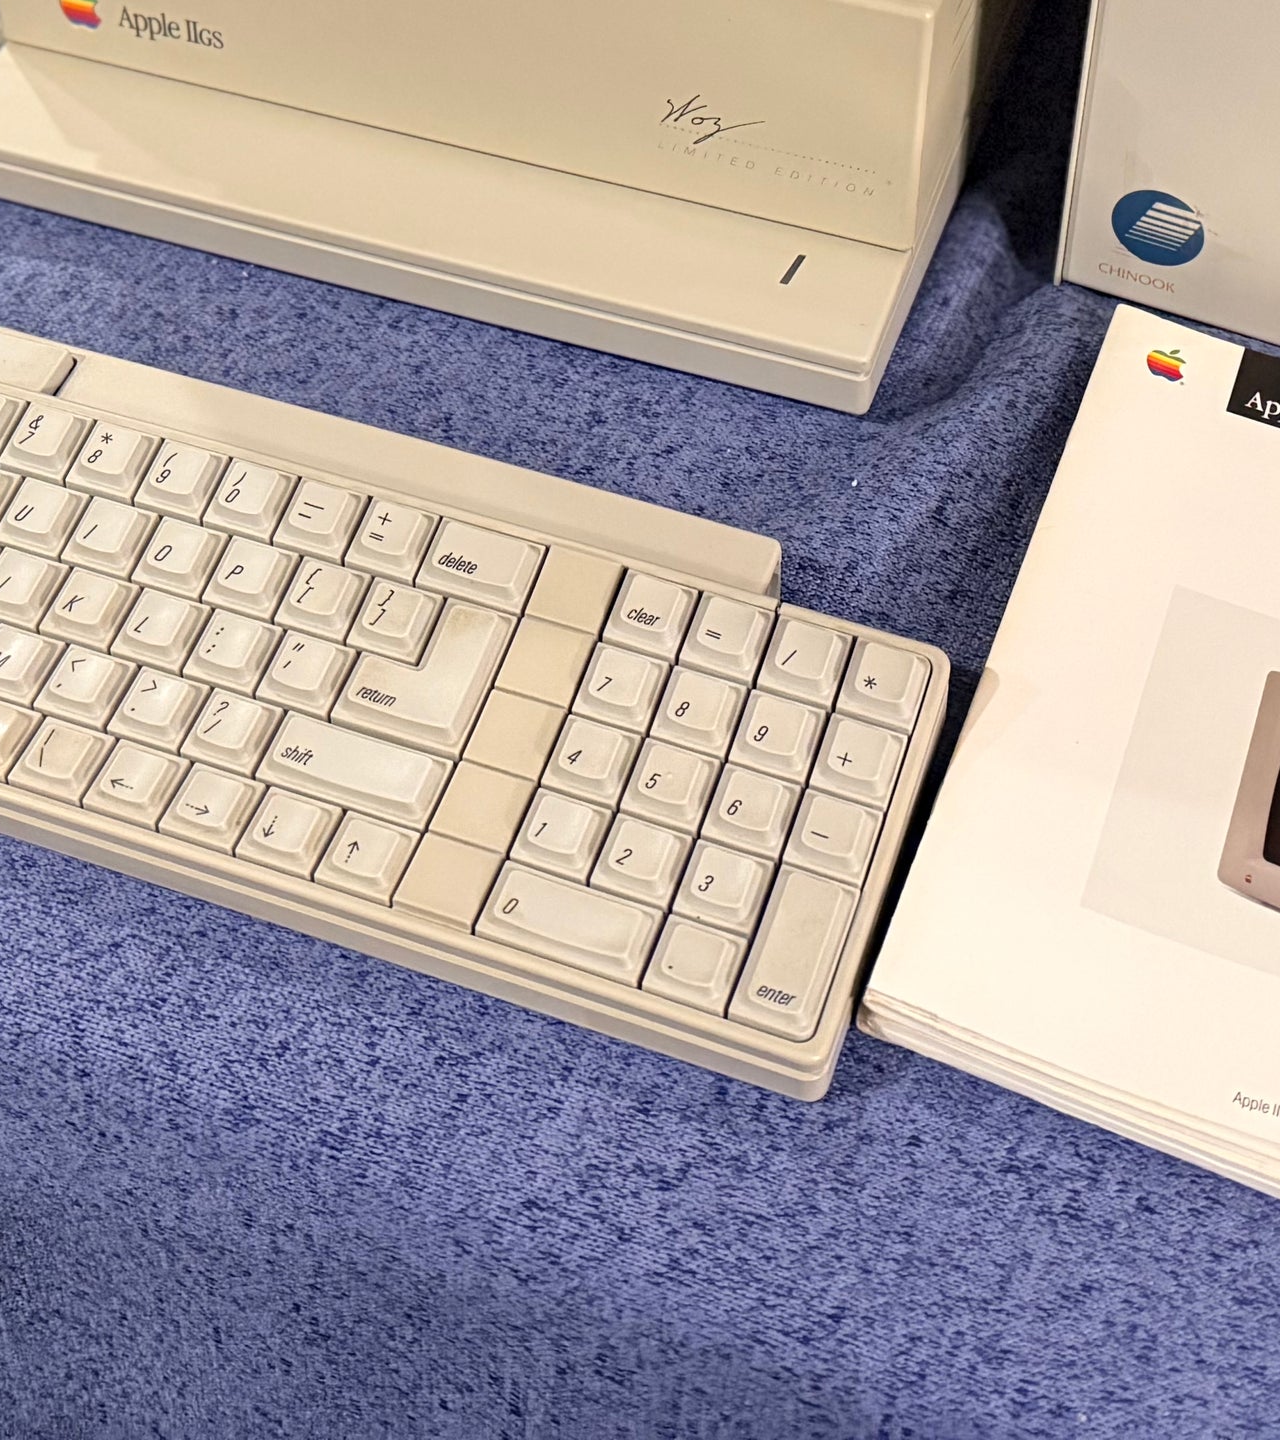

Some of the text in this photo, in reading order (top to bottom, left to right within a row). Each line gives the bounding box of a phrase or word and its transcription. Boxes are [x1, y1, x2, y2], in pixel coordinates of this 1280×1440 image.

[118, 6, 181, 40] Apple
[661, 94, 766, 144] Woz
[657, 142, 876, 197] LIMITED EDITION
[1098, 262, 1176, 294] CHINOOK
[28, 414, 44, 431] &
[18, 430, 36, 445] 7
[86, 449, 103, 464] 8
[155, 468, 172, 484] 9
[13, 504, 35, 522] U
[378, 512, 392, 526] +
[368, 531, 385, 542] =
[437, 551, 478, 575] delete
[224, 564, 245, 580] P
[61, 594, 84, 613] K
[133, 616, 149, 634] L
[626, 607, 661, 626] clear
[705, 628, 722, 640] =
[596, 676, 613, 692] 7
[355, 686, 397, 707] return
[212, 700, 230, 717] ?
[674, 701, 691, 718] 8
[753, 725, 769, 742] 9
[280, 745, 314, 766] shift
[567, 749, 583, 765] 4
[837, 752, 853, 767] +
[644, 772, 662, 790] 5
[726, 799, 743, 816] 6
[534, 822, 548, 837] 1
[615, 848, 633, 866] 2
[697, 874, 715, 892] 3
[756, 985, 797, 1006] enter
[1231, 1091, 1270, 1114] Apple
